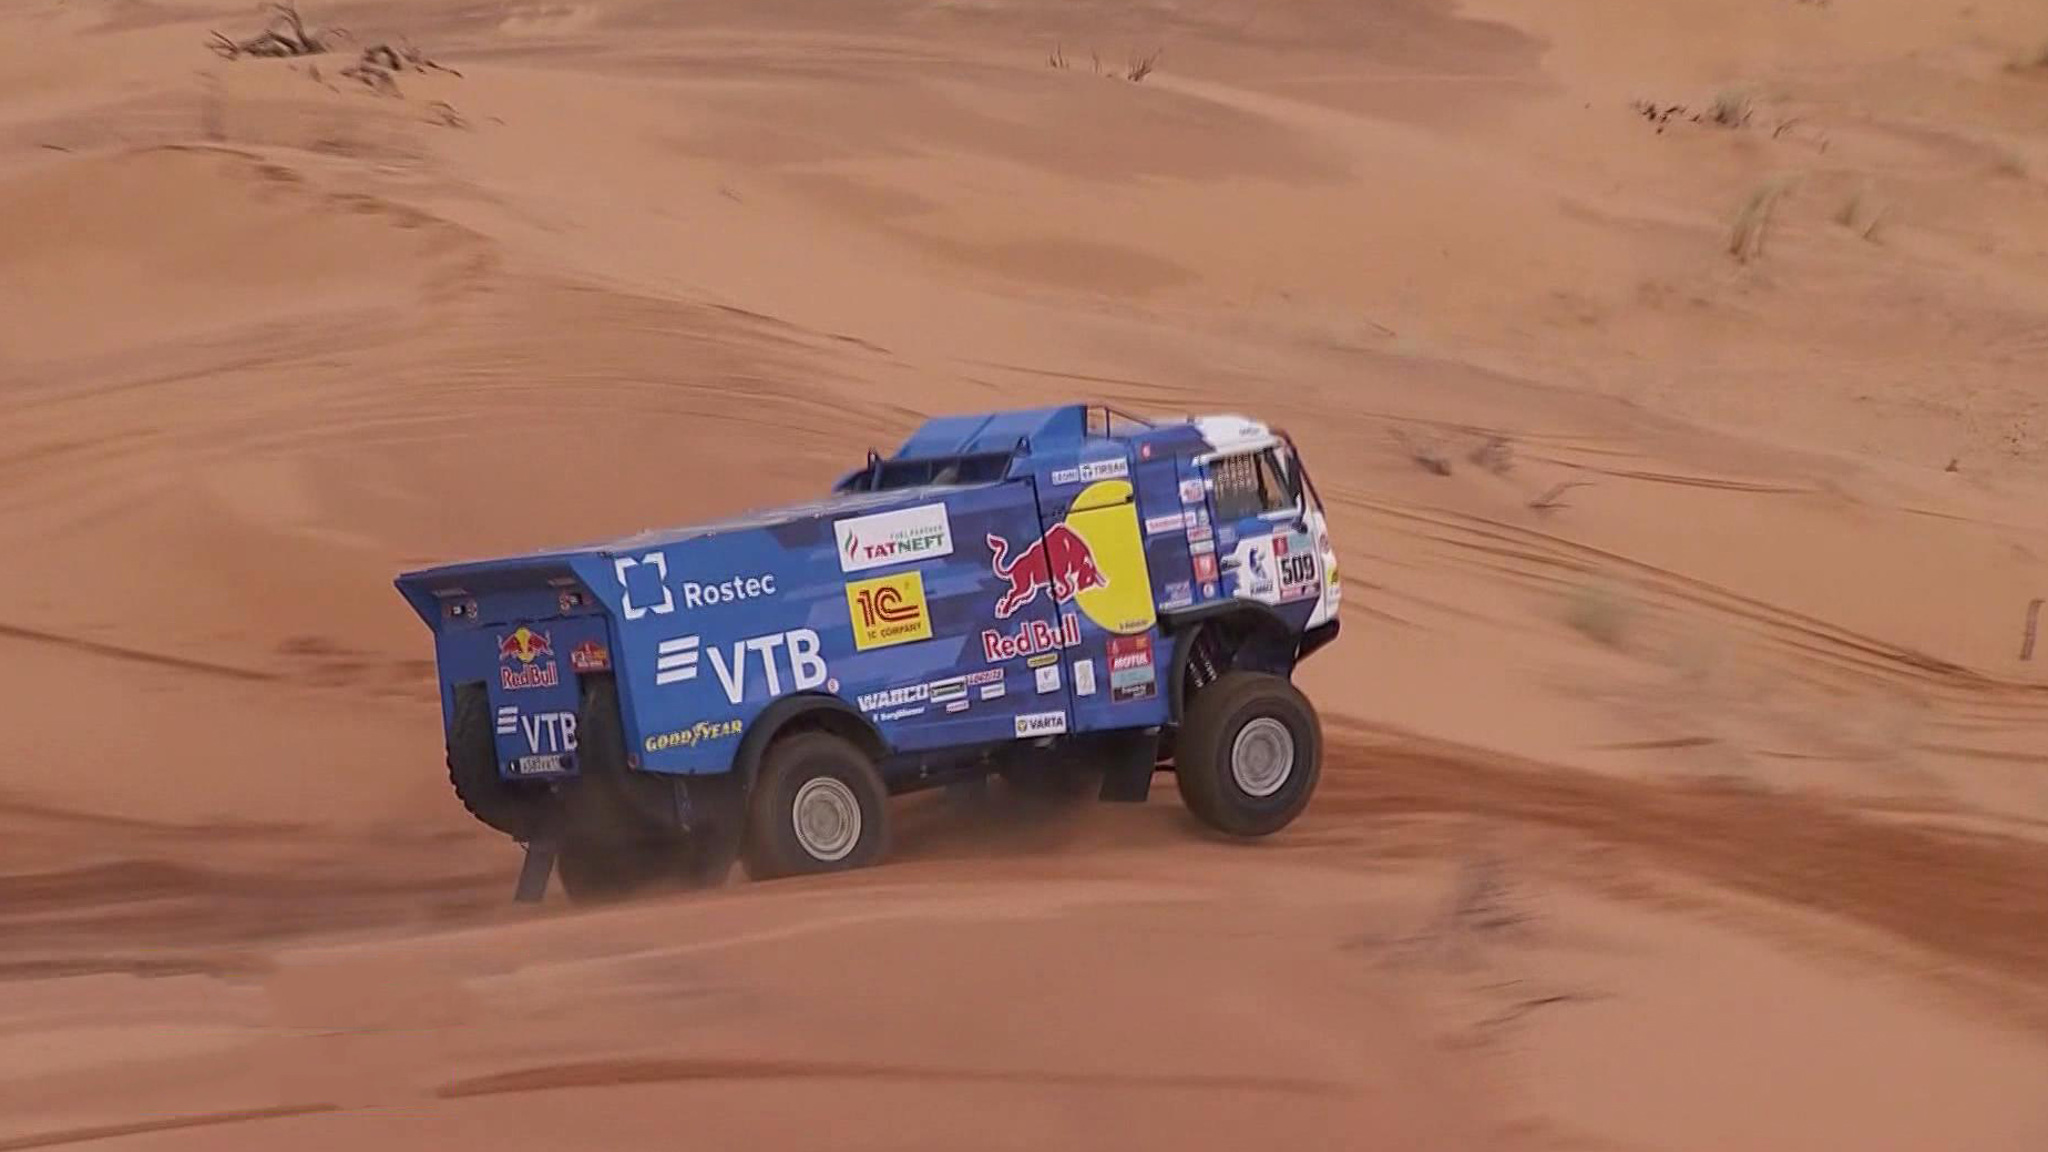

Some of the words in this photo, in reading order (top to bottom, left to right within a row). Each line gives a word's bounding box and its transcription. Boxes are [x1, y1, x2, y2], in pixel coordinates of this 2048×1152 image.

[864, 534, 944, 559] TATNEFT
[1281, 553, 1315, 585] 509
[684, 574, 776, 609] Rostec
[881, 622, 921, 638] COMPANY
[982, 620, 1031, 662] Red
[1033, 613, 1081, 653] Bull
[501, 662, 531, 690] Red
[531, 660, 558, 688] Bull
[706, 628, 828, 704] VTB
[521, 712, 578, 754] VTB
[1029, 717, 1063, 729] VARTA
